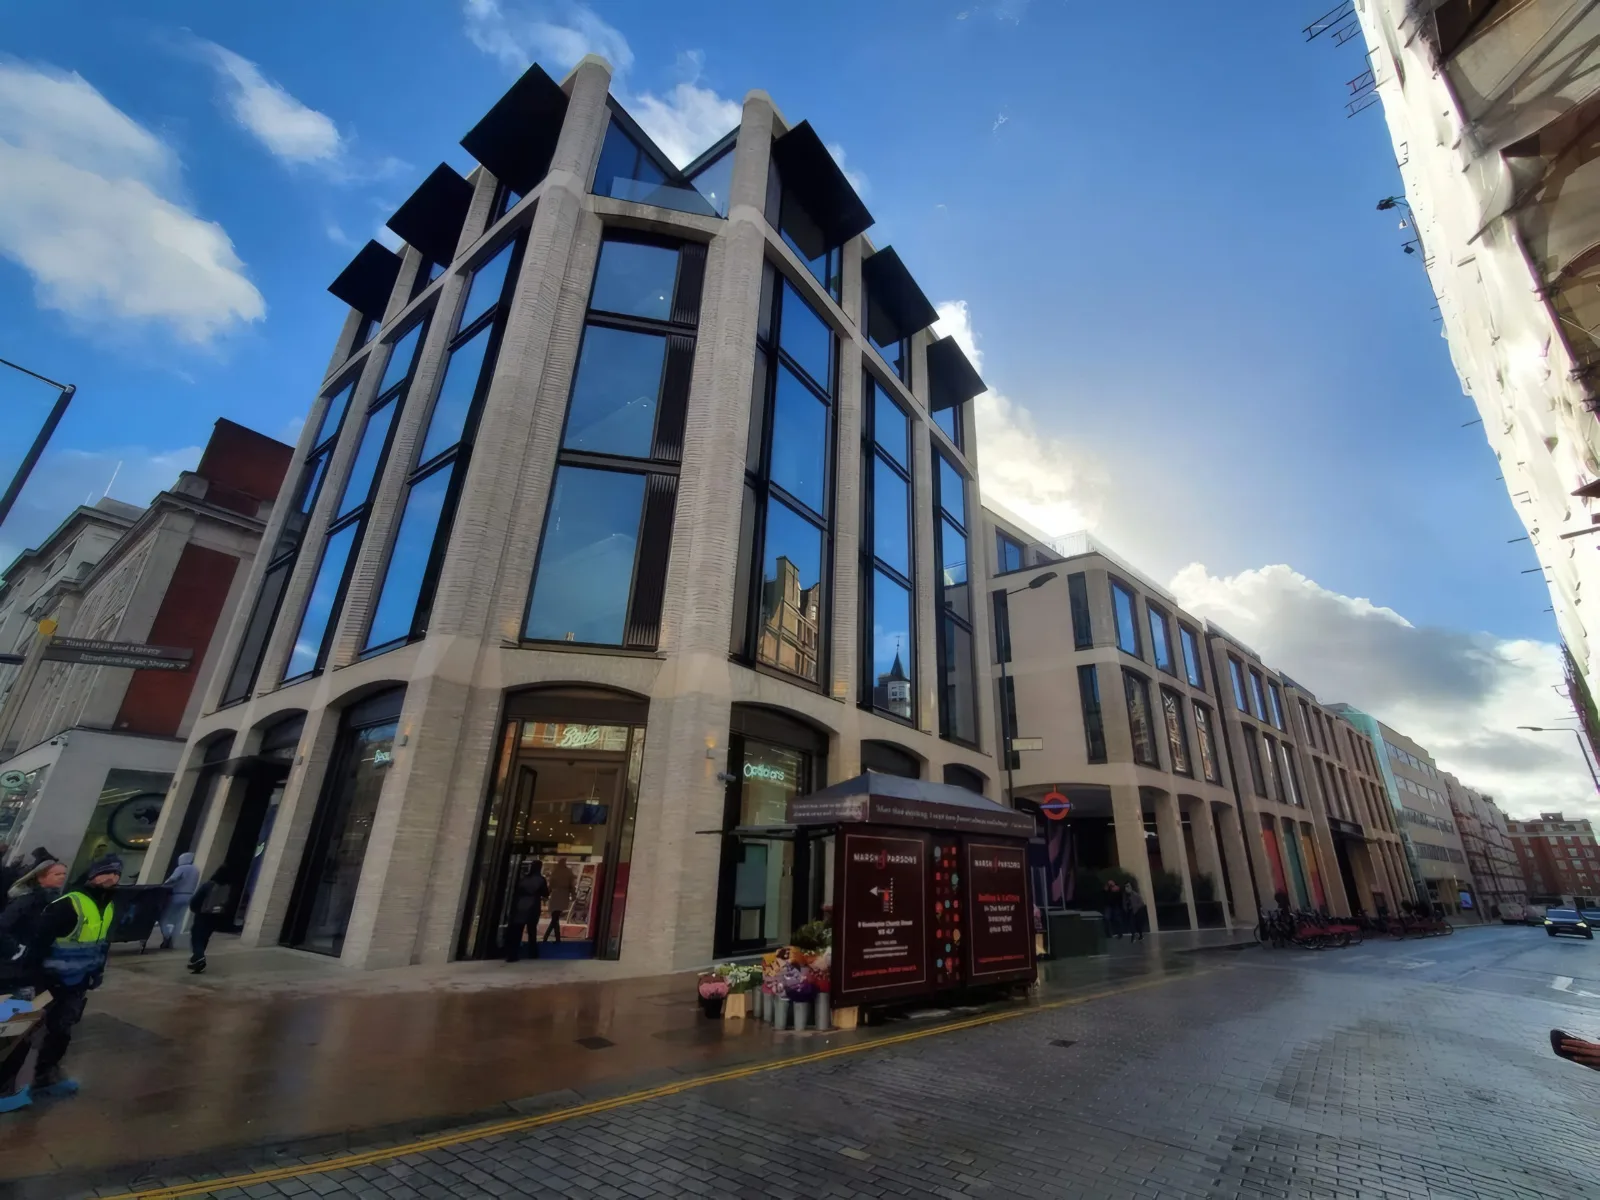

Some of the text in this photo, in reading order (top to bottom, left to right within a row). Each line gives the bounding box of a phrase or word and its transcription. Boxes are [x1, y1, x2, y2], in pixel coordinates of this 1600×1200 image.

[560, 726, 600, 747] Boots
[887, 854, 917, 865] PARSONS
[974, 859, 993, 867] MARSH
[998, 860, 1021, 869] PARSONS
